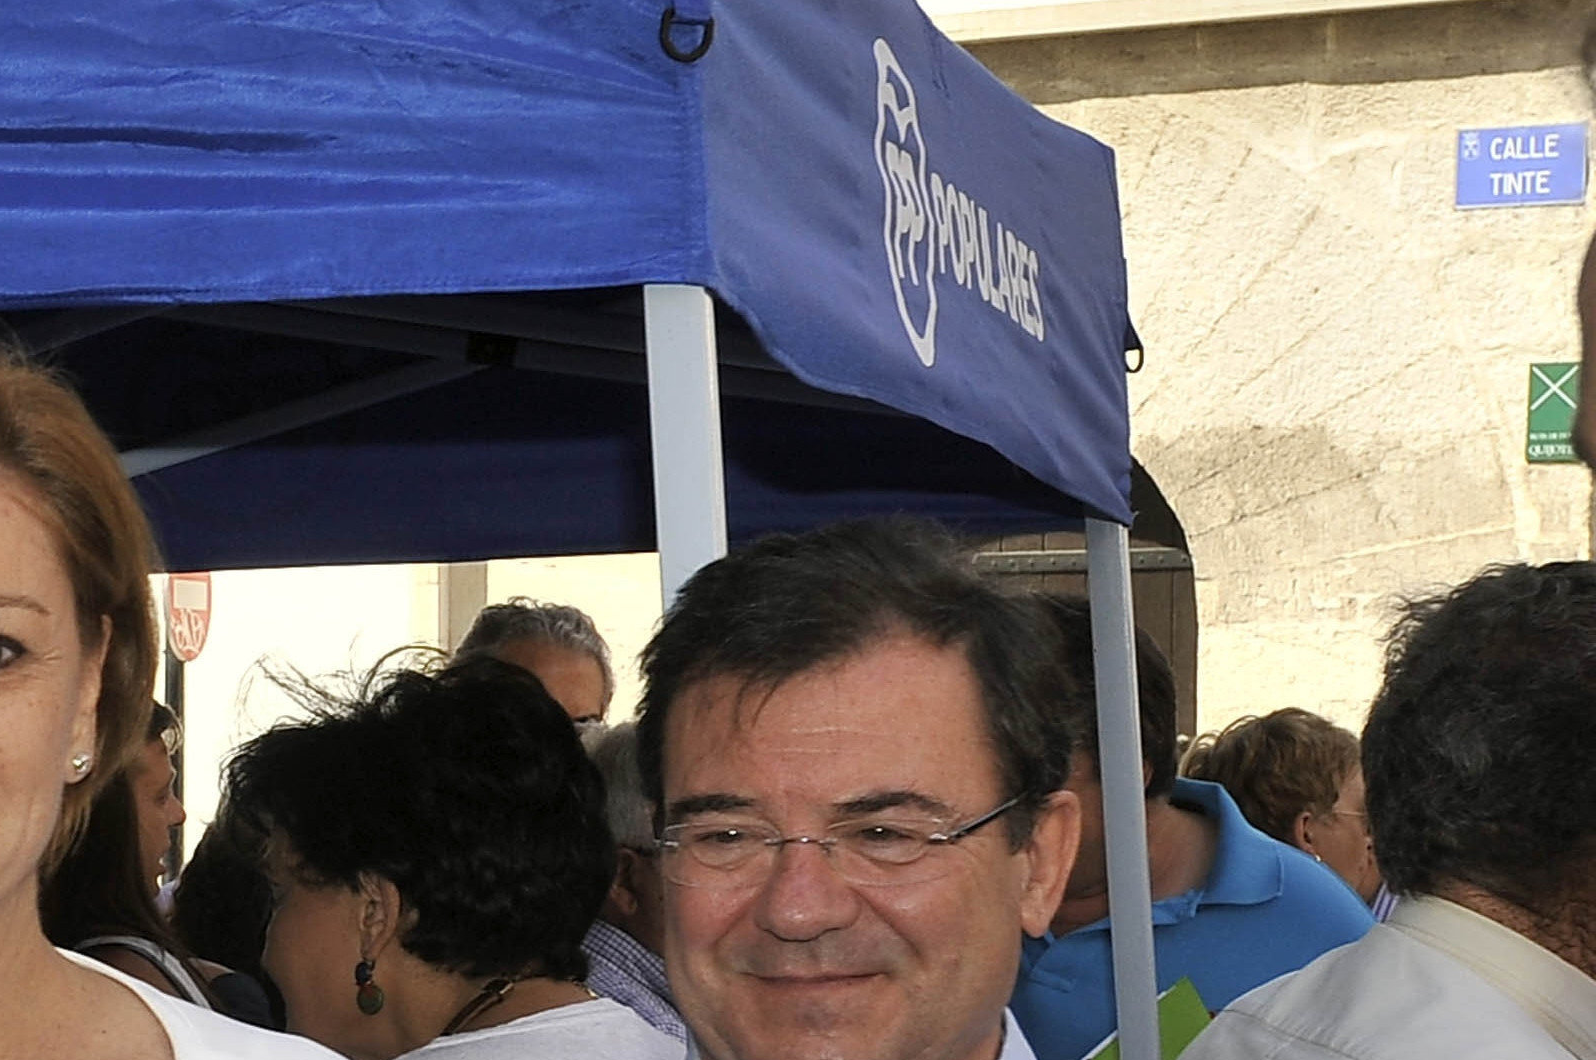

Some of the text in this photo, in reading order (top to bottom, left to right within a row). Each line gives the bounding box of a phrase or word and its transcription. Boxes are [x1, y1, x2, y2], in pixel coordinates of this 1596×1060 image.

[1489, 133, 1561, 160] CALLE
[1489, 170, 1552, 196] TINTE
[930, 172, 1045, 342] POPULARES
